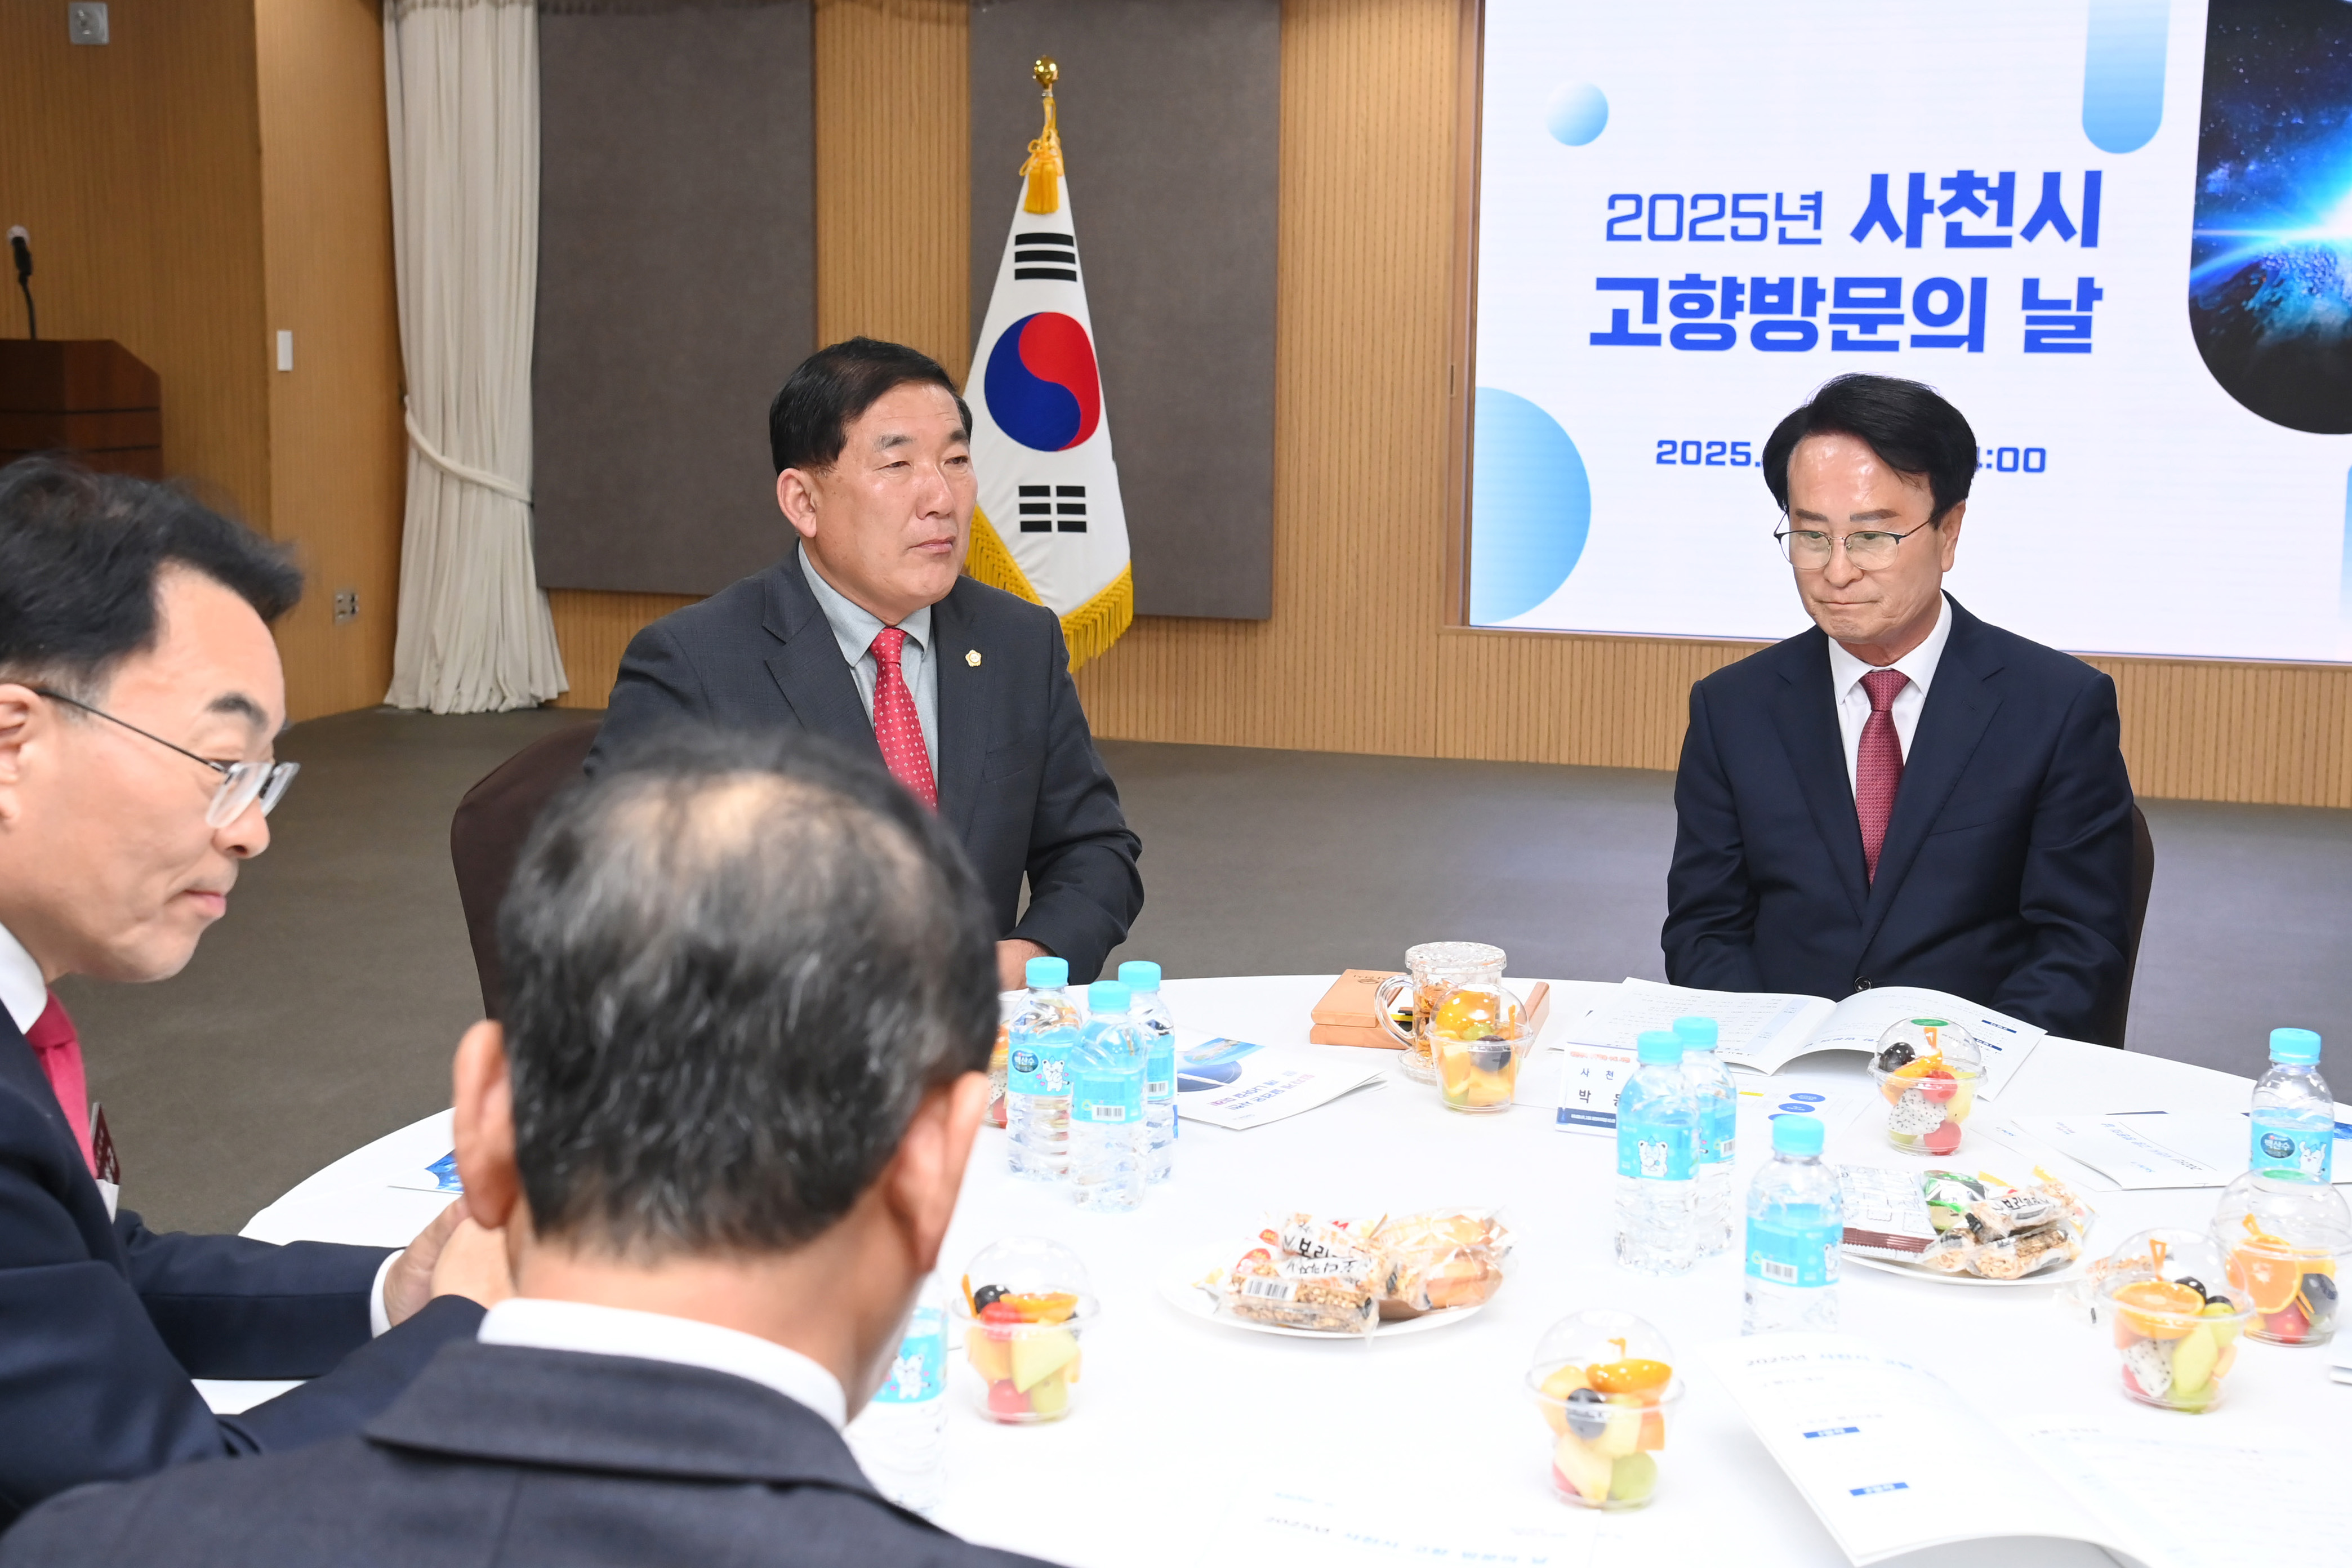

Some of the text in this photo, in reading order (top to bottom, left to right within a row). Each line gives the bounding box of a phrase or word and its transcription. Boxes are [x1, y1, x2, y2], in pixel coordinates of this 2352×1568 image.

[1605, 169, 2103, 249] 2025년 사천시
[1589, 273, 2104, 354] 고향방문의 날
[1656, 439, 1761, 467] 2025.
